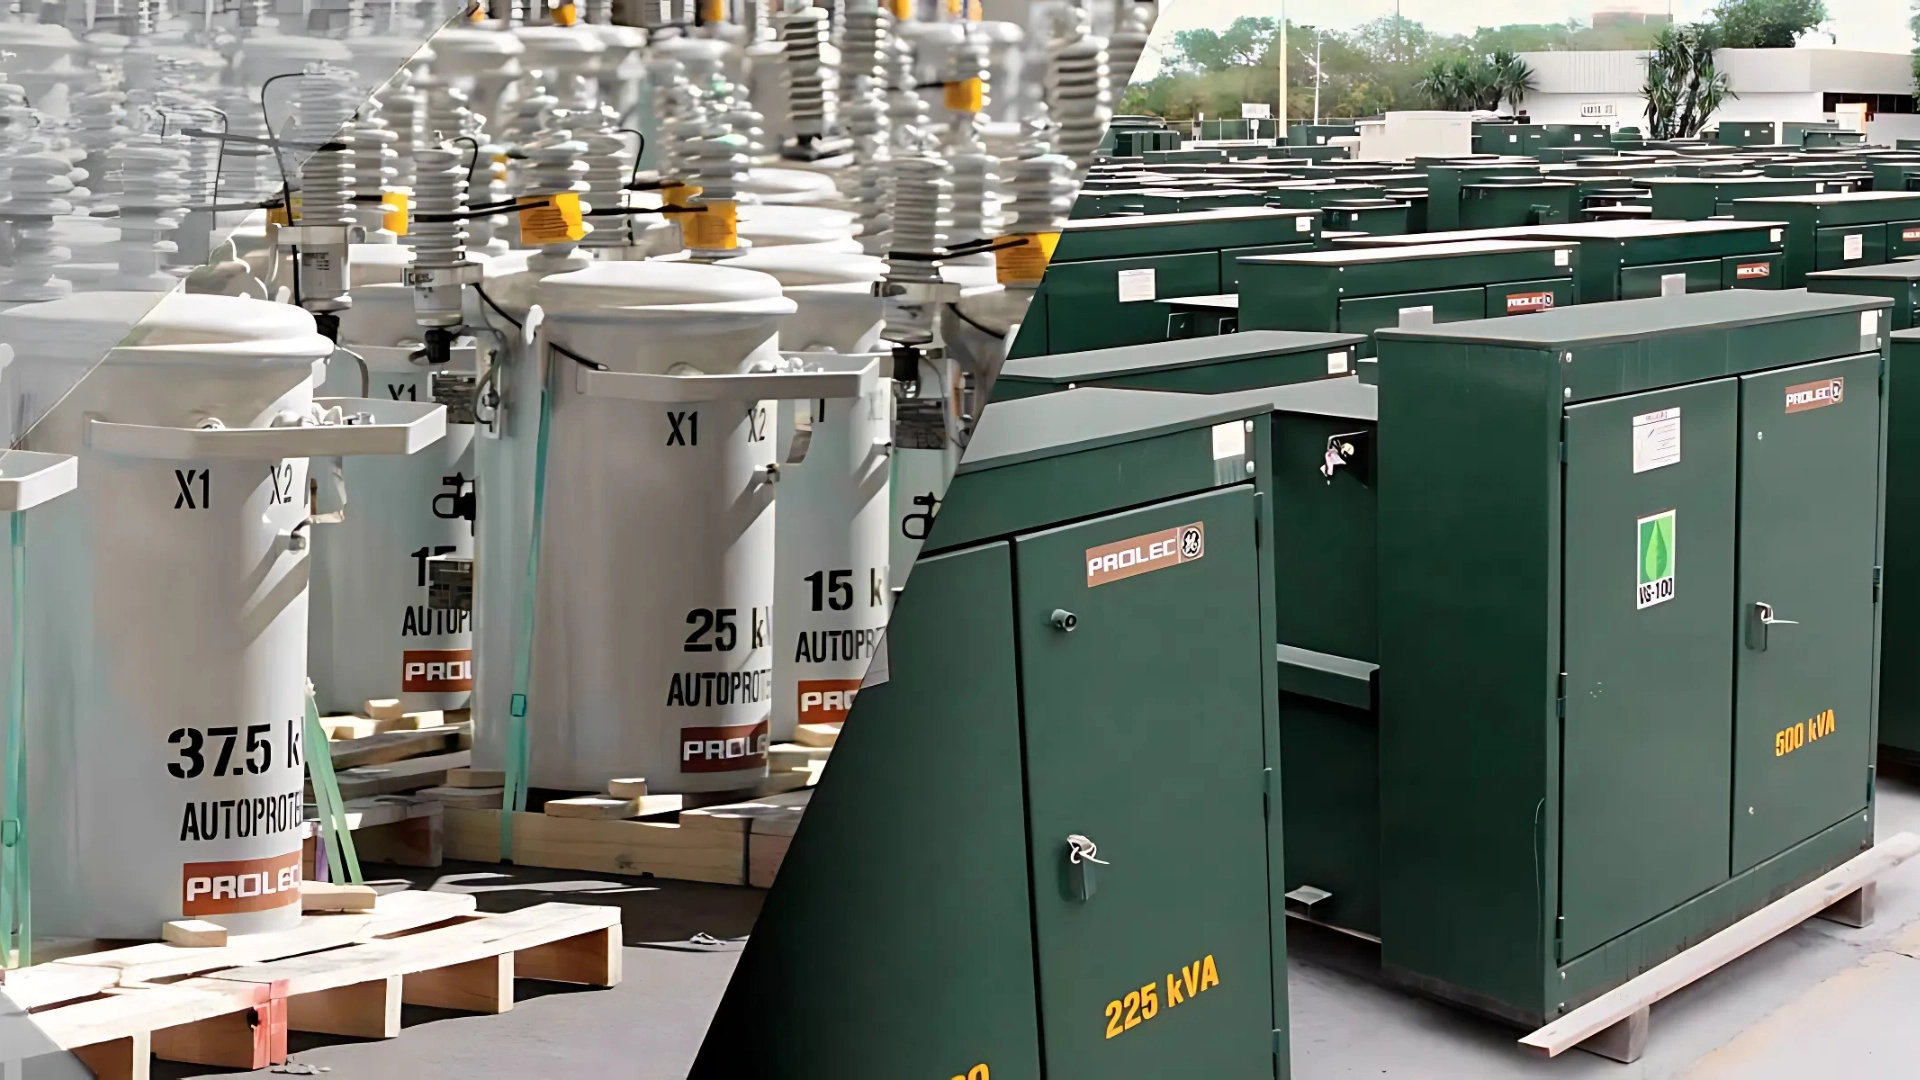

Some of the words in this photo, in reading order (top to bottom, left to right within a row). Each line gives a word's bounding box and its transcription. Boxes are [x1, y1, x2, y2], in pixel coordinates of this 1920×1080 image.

[666, 410, 698, 446] X1
[747, 407, 766, 442] X2
[174, 469, 210, 509] X1
[270, 463, 293, 505] X2
[1088, 538, 1177, 577] PROLEC
[804, 569, 854, 611] 15
[401, 605, 473, 637] AUTOP
[684, 608, 737, 652] 25
[167, 723, 272, 779] 37.5
[1775, 722, 1804, 757] 500
[1808, 708, 1835, 743] kVA
[1105, 982, 1159, 1040] 225
[1166, 954, 1220, 1008] kVA
